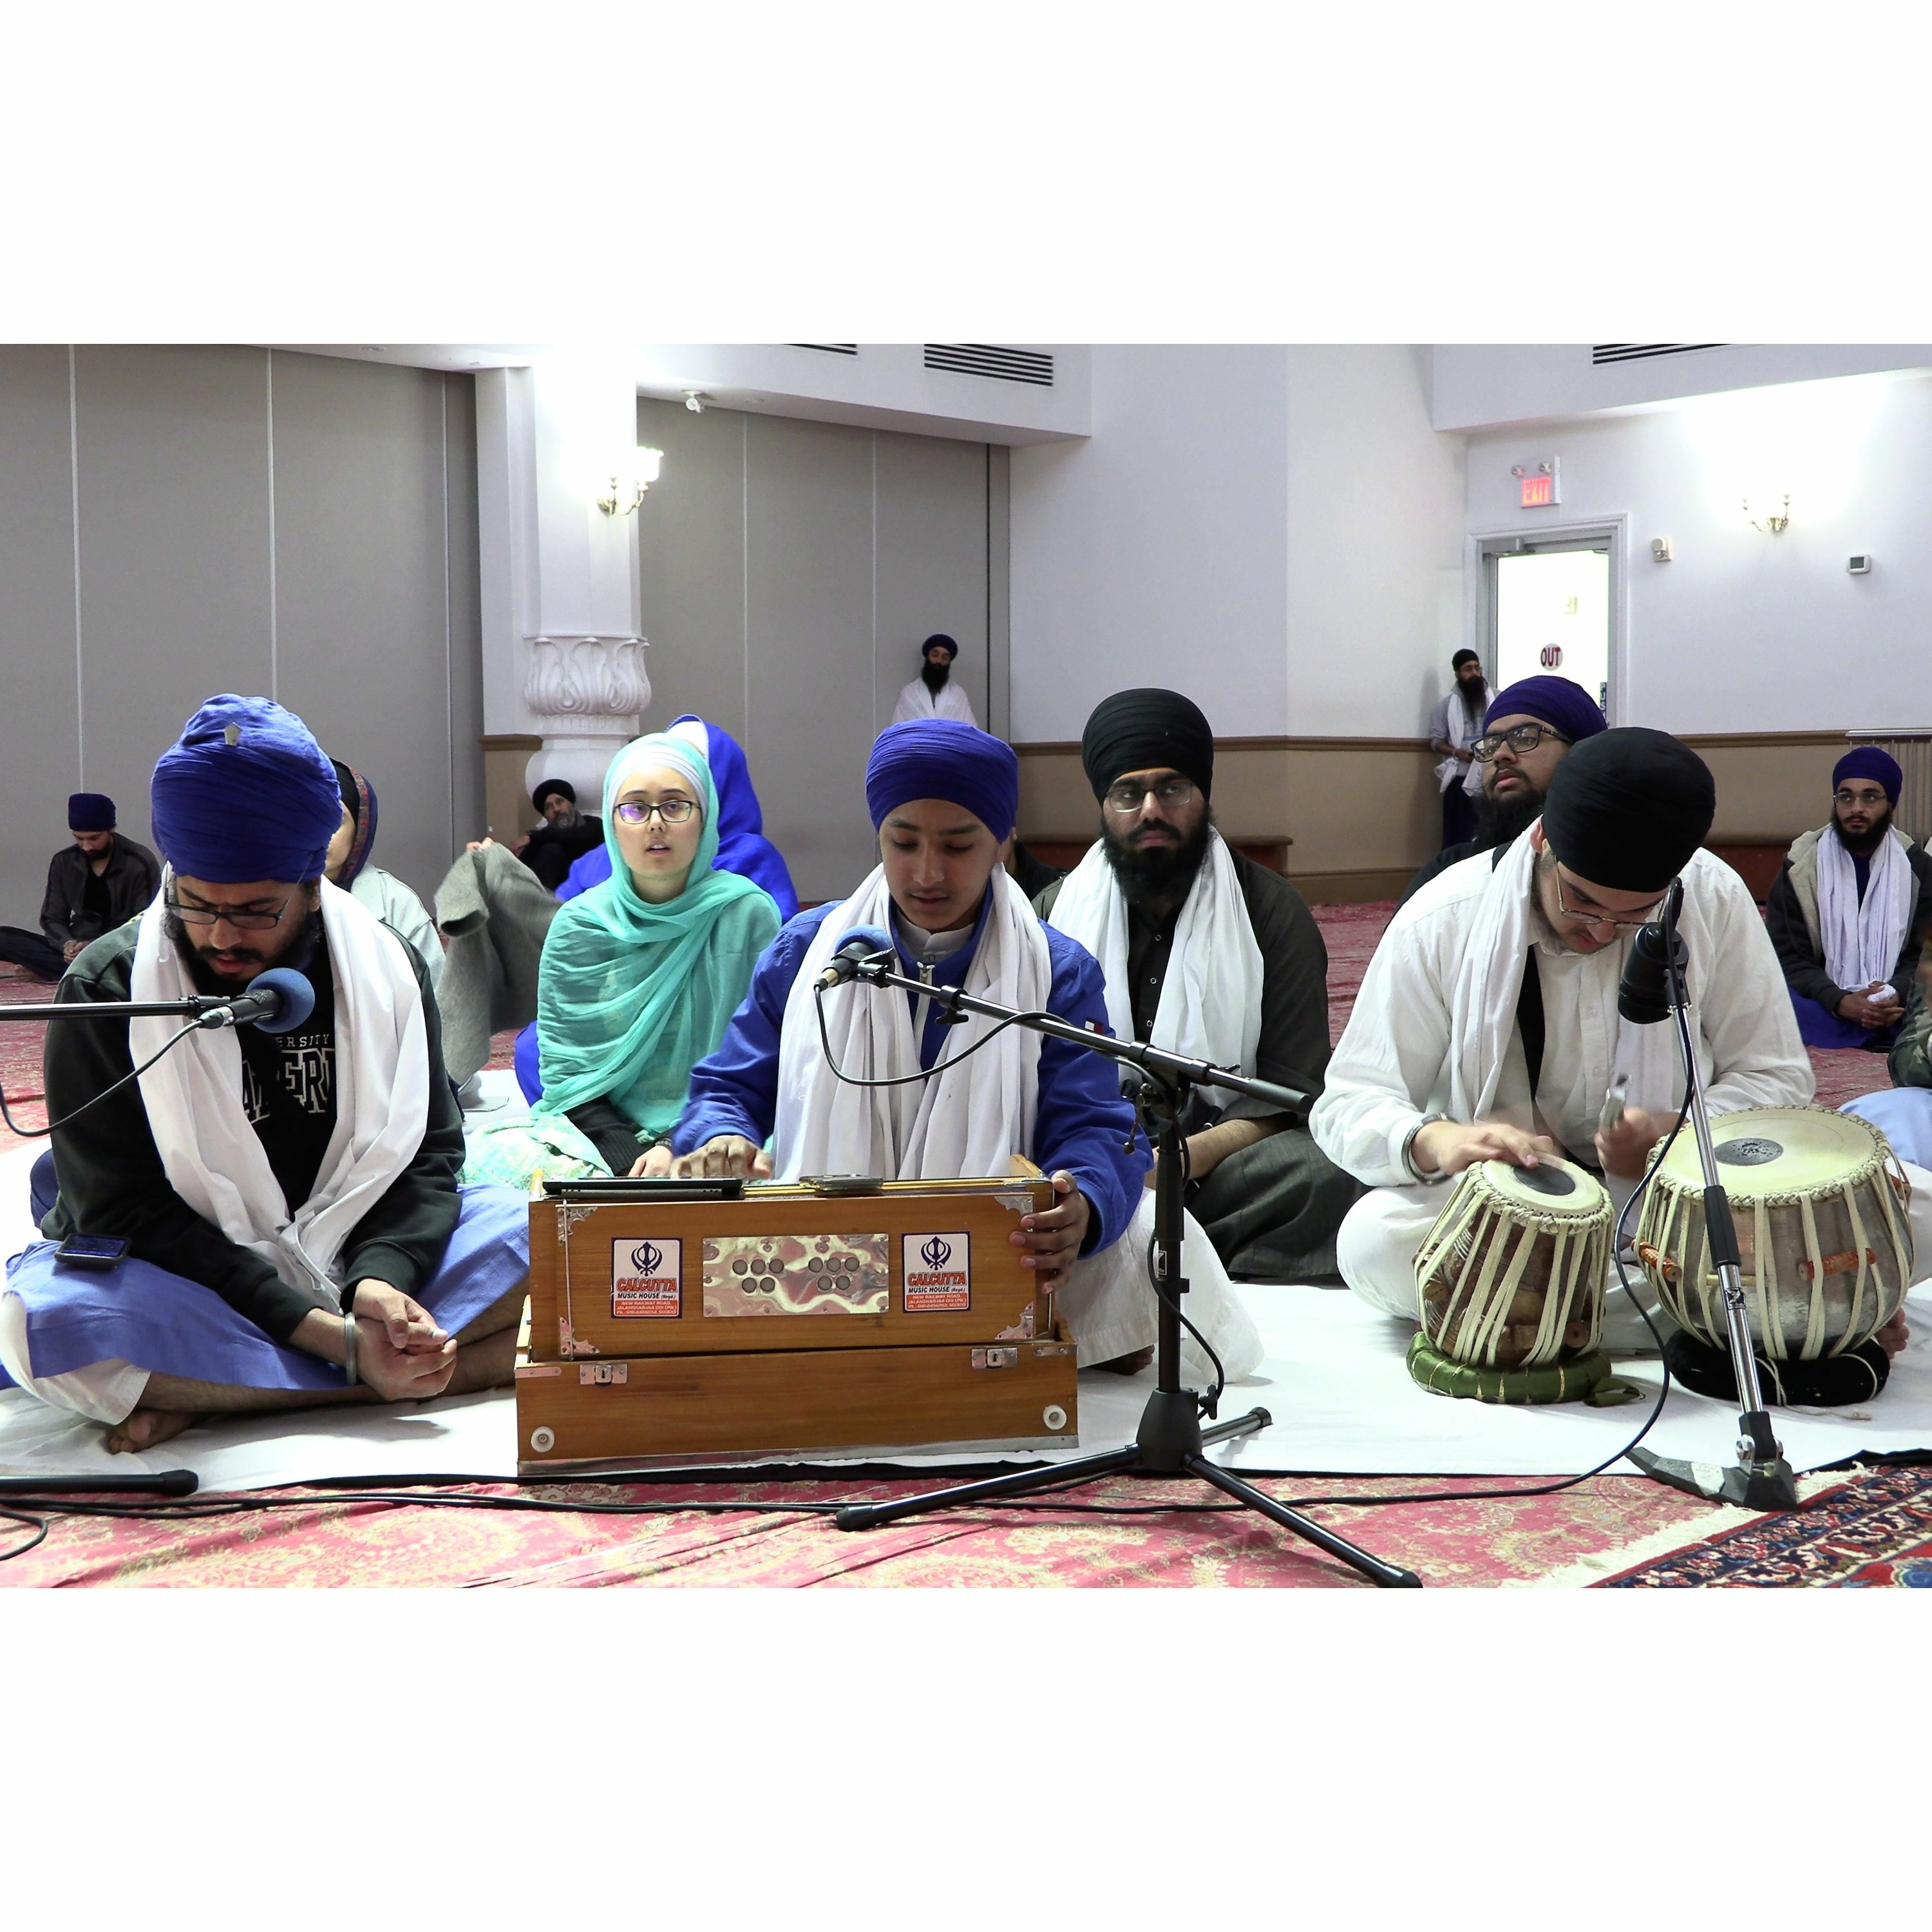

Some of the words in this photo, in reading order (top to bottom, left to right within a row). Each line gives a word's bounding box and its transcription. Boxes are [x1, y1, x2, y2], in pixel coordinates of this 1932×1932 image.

[1523, 478, 1550, 504] EXIT
[1540, 647, 1560, 667] OUT
[616, 1278, 677, 1293] CALCUTTA
[907, 1271, 967, 1286] CALCUTTA
